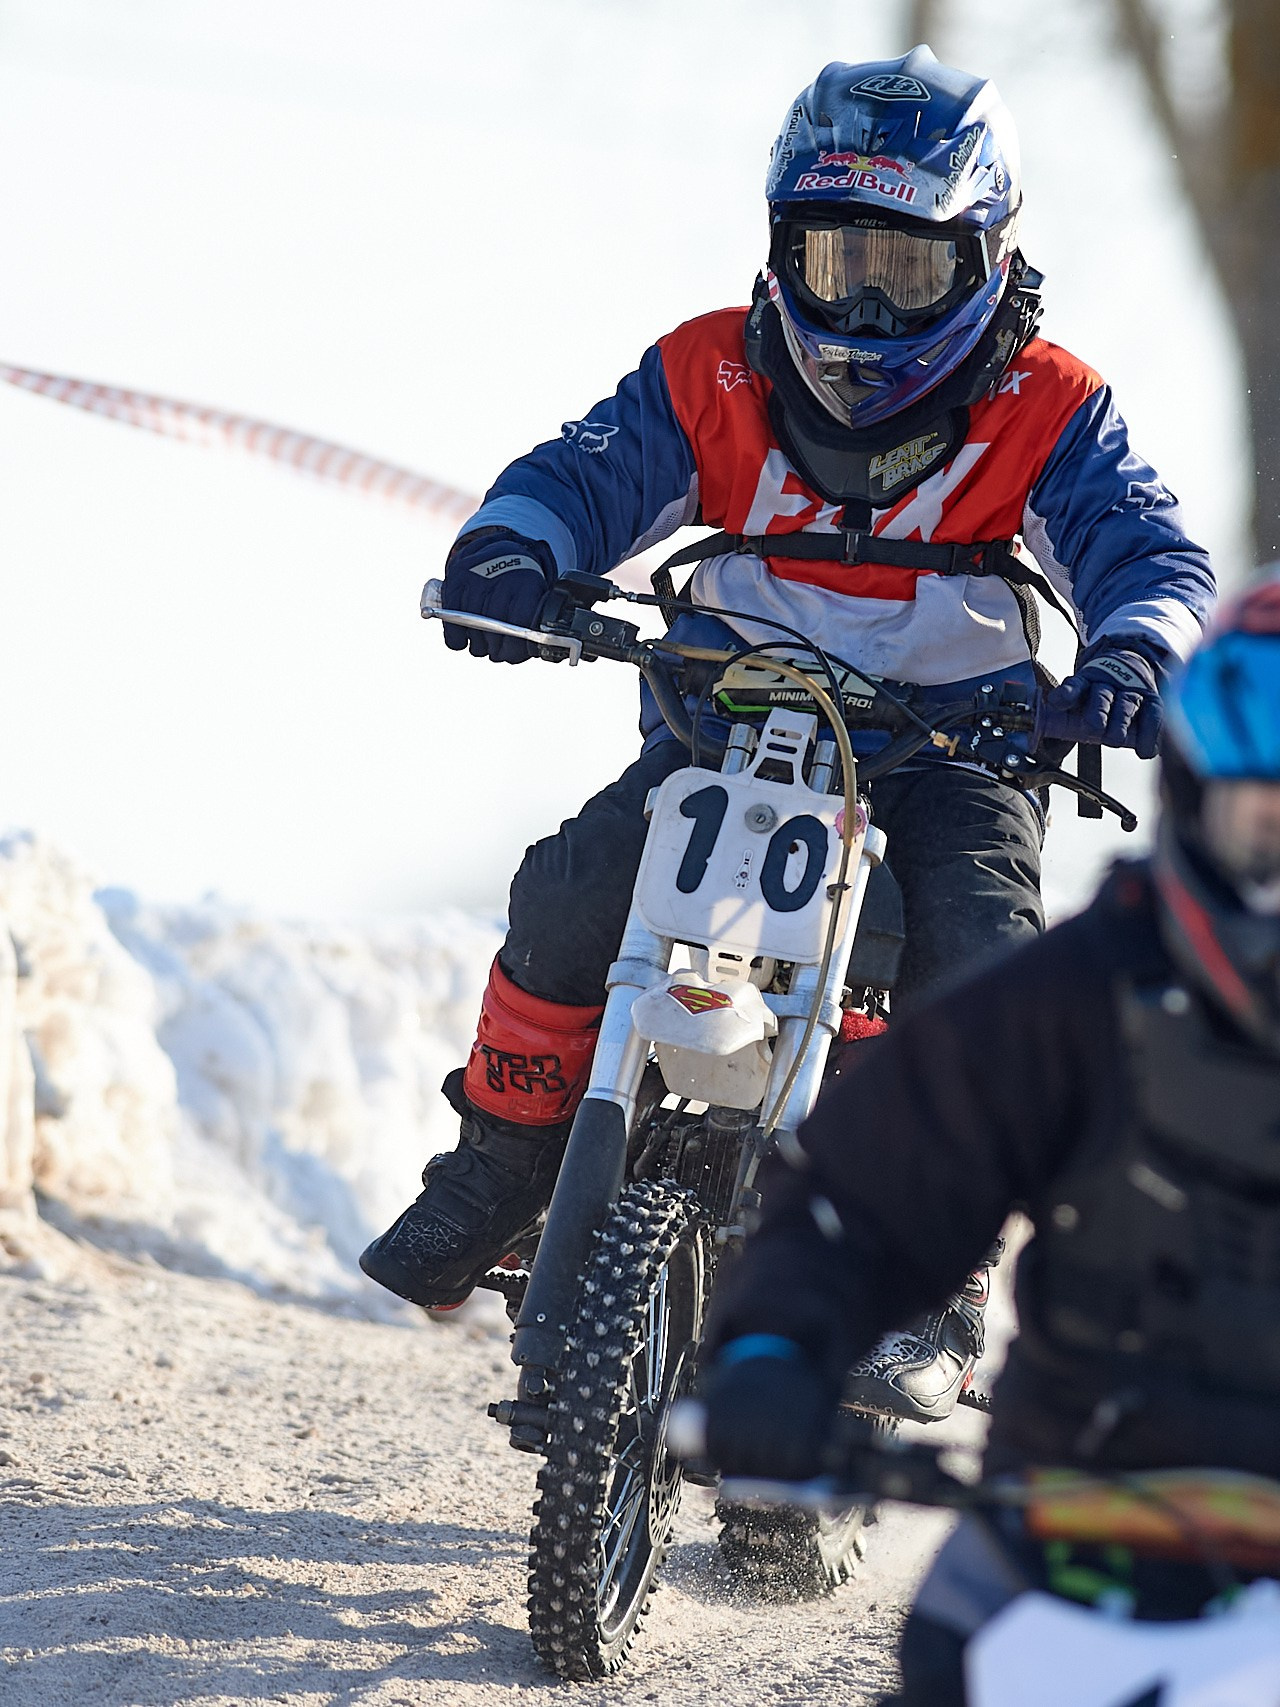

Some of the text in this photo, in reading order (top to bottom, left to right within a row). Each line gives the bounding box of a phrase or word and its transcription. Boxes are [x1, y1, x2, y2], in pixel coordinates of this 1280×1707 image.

[794, 170, 918, 205] Red Bull
[485, 558, 521, 576] SPORT
[1098, 659, 1134, 682] SPORT
[676, 784, 829, 913] 10
